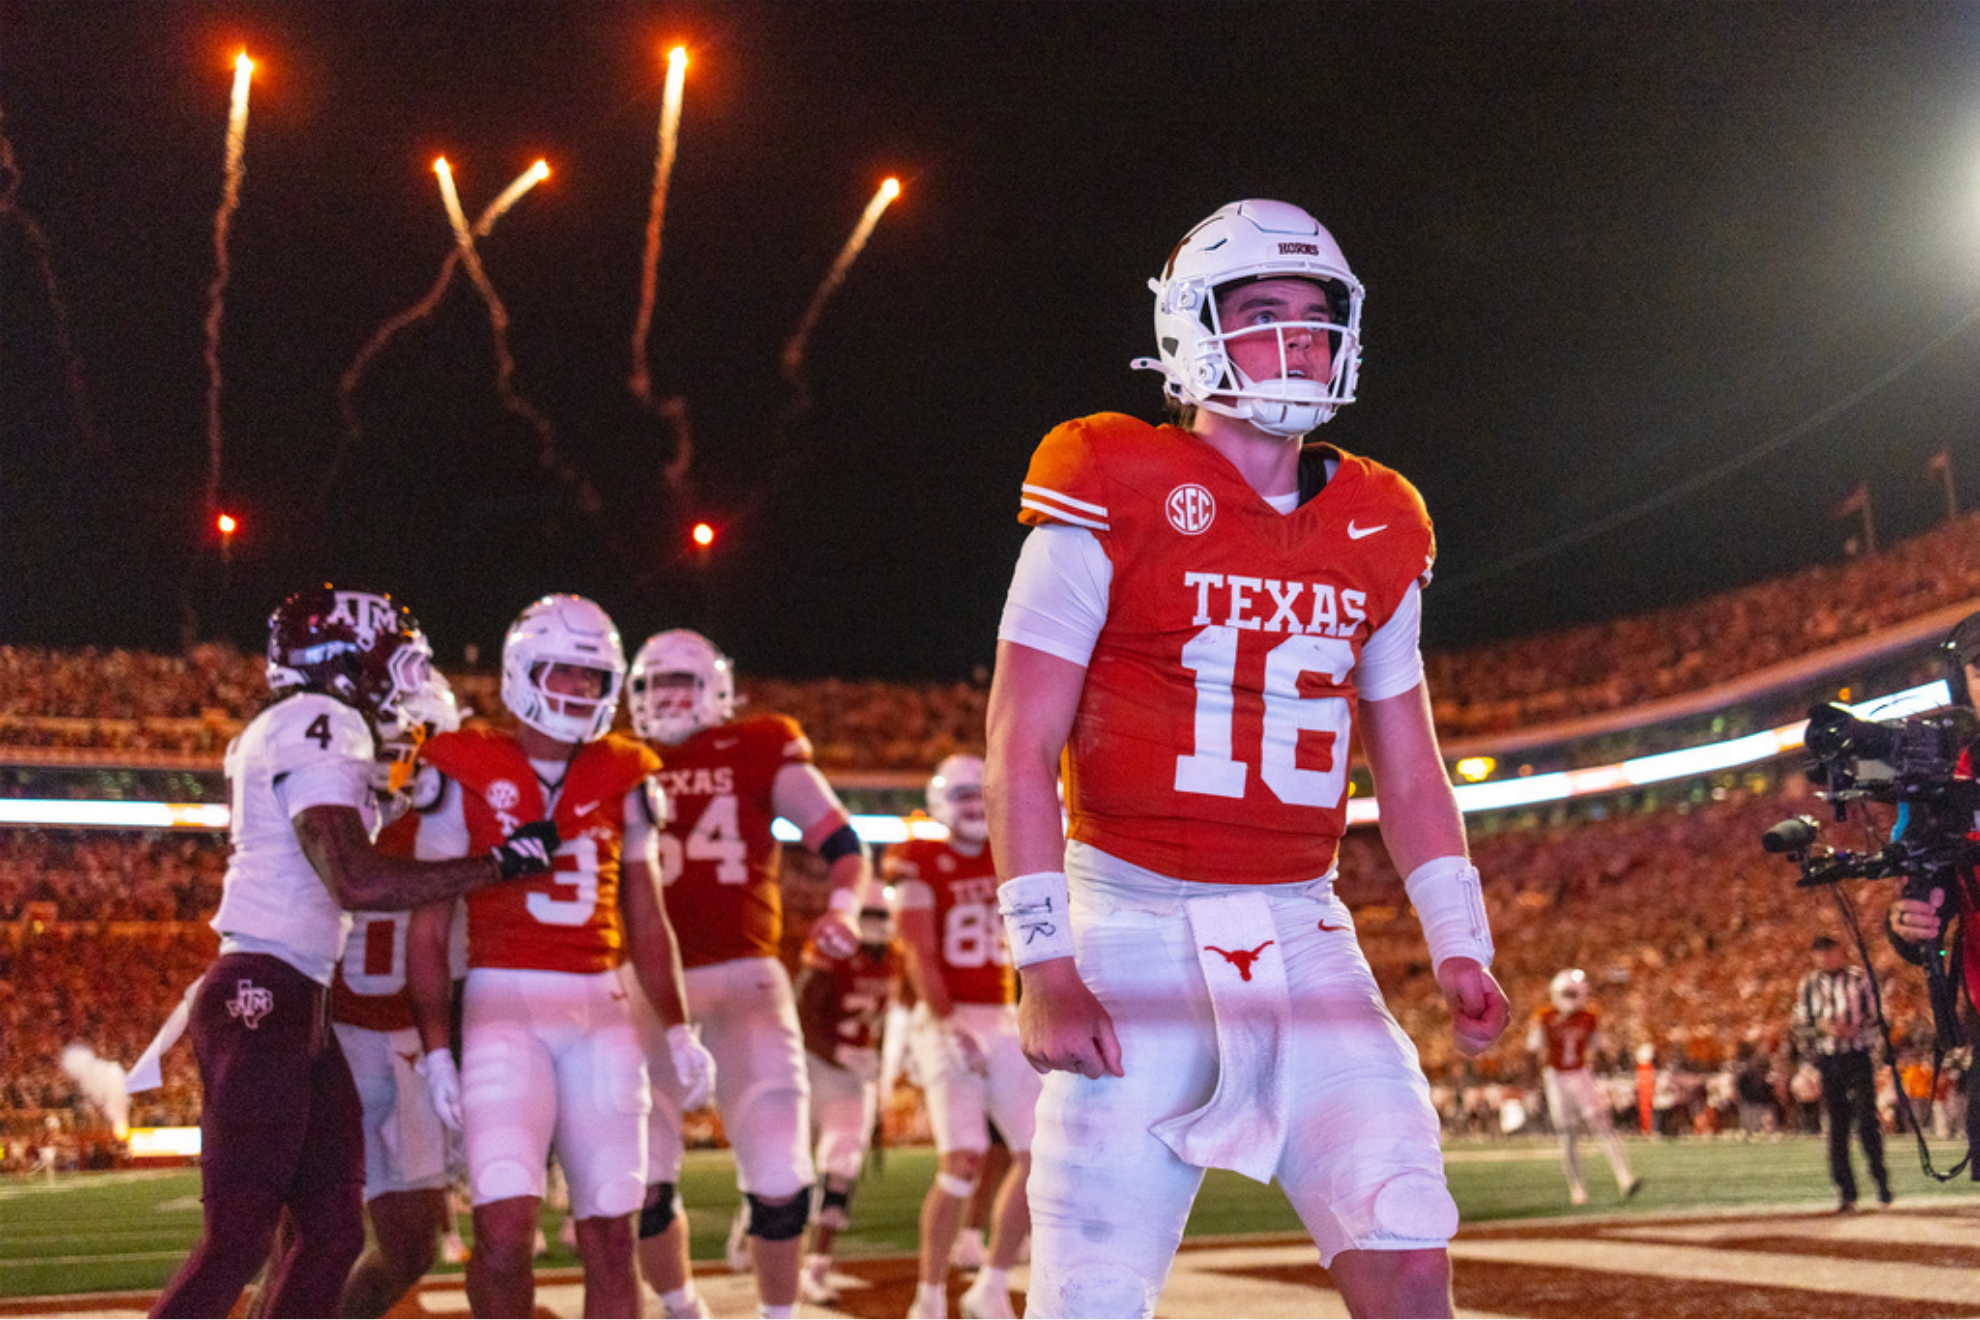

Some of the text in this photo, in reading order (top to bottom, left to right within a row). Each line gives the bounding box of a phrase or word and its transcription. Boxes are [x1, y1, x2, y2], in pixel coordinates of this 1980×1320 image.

[1170, 487, 1211, 531] SEC
[1184, 571, 1367, 637] TEXAS
[304, 713, 332, 750] 4
[1174, 624, 1357, 809] 16
[657, 766, 734, 796] EXAS
[525, 835, 600, 926] 3
